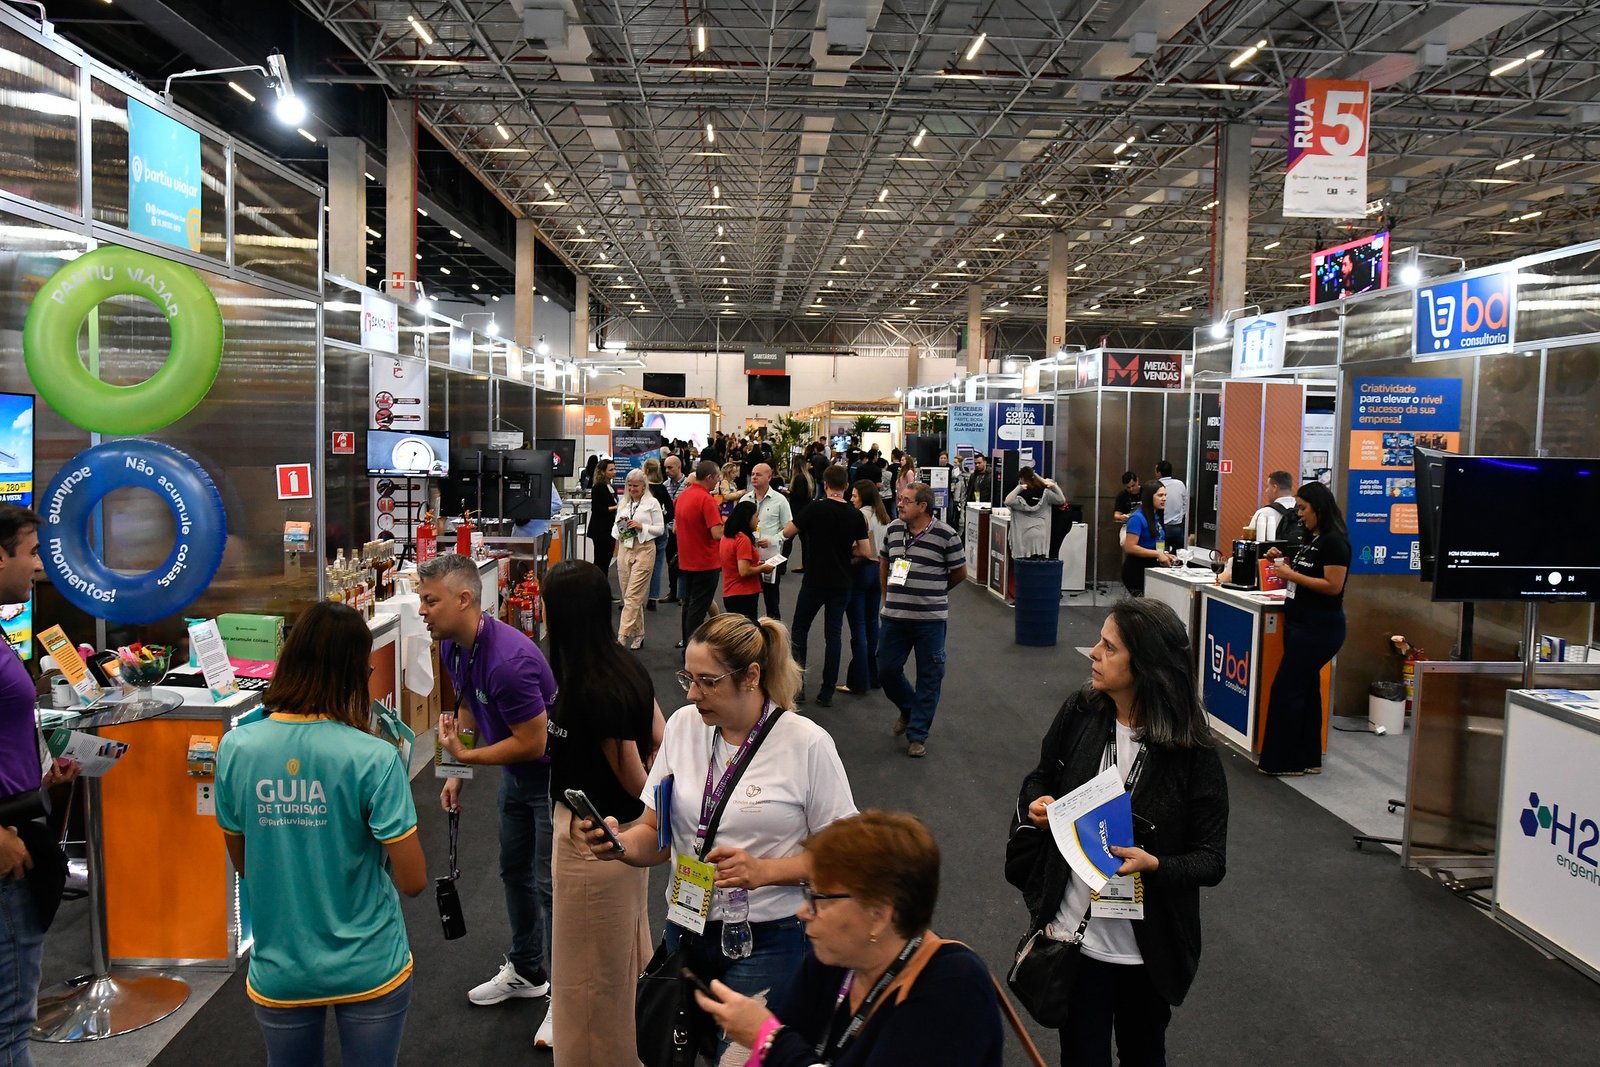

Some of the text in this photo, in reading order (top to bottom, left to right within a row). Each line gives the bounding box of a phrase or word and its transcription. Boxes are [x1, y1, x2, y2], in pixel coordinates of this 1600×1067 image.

[1293, 98, 1315, 148] RUA
[1320, 90, 1364, 157] 5
[144, 168, 198, 198] partiu viajar
[51, 266, 178, 317] PARTIU VIAJAR
[1461, 283, 1508, 333] bd
[1460, 332, 1507, 347] consultoria
[1143, 371, 1180, 381] VENDAS
[1360, 383, 1416, 393] Criatividade
[647, 400, 698, 409] ATIBAIA
[1360, 395, 1443, 404] para elevar o nível
[1405, 405, 1418, 413] da
[1419, 406, 1436, 414] sua
[1359, 415, 1402, 424] empresa!
[125, 456, 154, 477] Não
[157, 476, 192, 535] acumule
[1374, 545, 1387, 559] BD
[49, 537, 116, 603] momentos!
[157, 544, 189, 587] coisas,
[1225, 642, 1249, 686] bd
[1225, 679, 1247, 697] consultoria
[255, 779, 327, 803] GUIA
[257, 804, 327, 815] DE TURISMO
